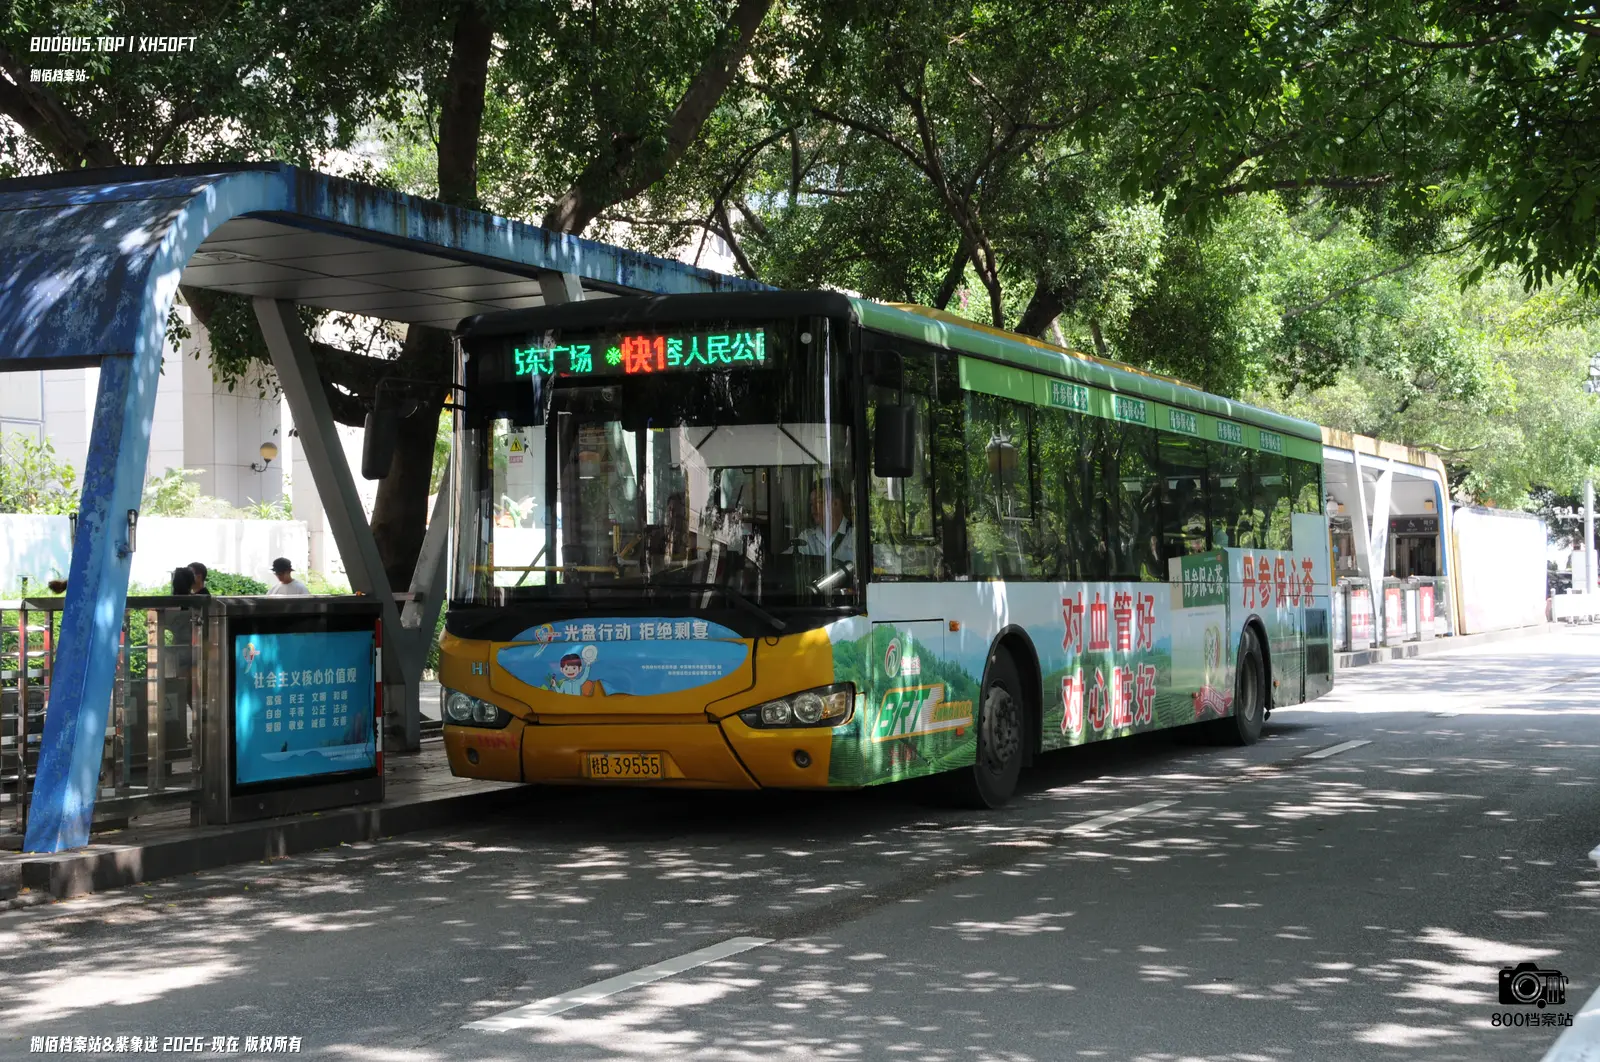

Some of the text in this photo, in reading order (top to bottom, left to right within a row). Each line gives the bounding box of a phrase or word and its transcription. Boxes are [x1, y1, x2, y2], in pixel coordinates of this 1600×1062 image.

[1242, 555, 1315, 609] 丹参保心茶
[564, 623, 631, 642] 光盘行动
[639, 620, 709, 641] 拒绝剩宴
[1061, 591, 1156, 654] 对血管好
[254, 668, 357, 689] 社会主义核心价值观
[265, 695, 282, 706] 富强
[289, 693, 305, 704] 民主
[311, 692, 327, 702] 文明
[265, 703, 348, 719] 自由 平等 公正 法治
[873, 688, 931, 738] BRT
[1060, 663, 1156, 735] 对心脏好
